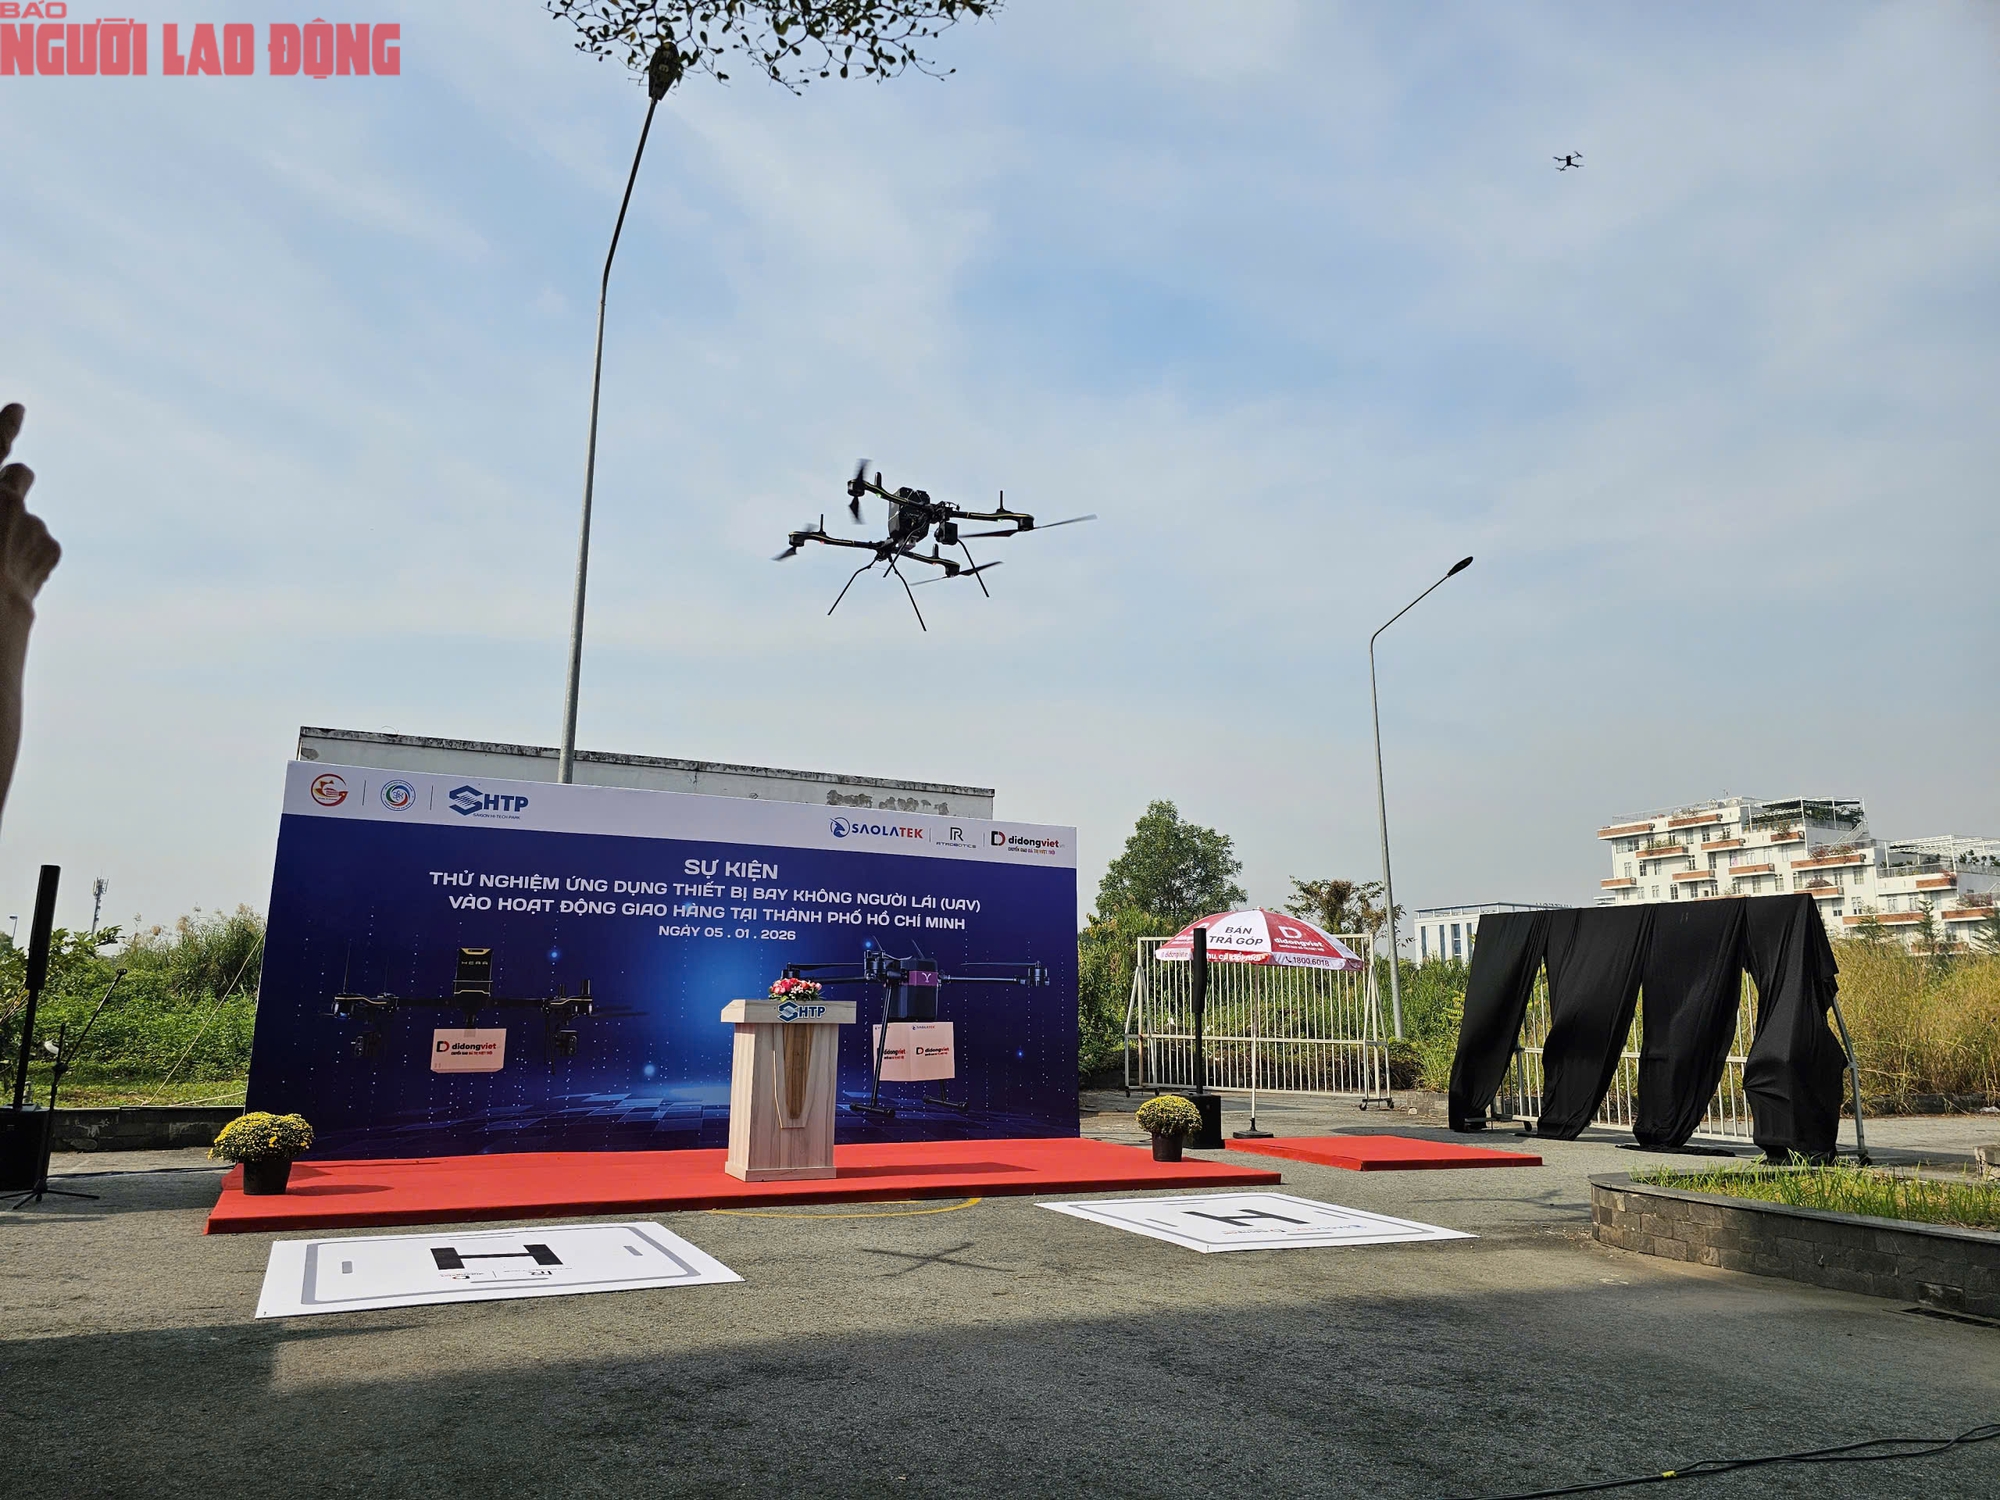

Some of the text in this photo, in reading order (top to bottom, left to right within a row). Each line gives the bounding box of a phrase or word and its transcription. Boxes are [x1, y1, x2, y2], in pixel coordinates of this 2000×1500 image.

[852, 823, 923, 839] SAOLATEK
[685, 859, 778, 881] SỰ KIỆN
[428, 869, 981, 913] THỬ NGHIỆM ỨNG DỤNG THIẾT BỊ BAY KHÔNG NGƯỜI LÁI (UAV)
[449, 893, 966, 930] VÀO HOẠT ĐỘNG GIAO HÀNG TẠI THÀNH PHỐ HỒ CHÍ MINH
[658, 924, 700, 937] NGÀY
[1225, 926, 1252, 934] BÁN
[1209, 935, 1264, 946] TRẢ GÓP
